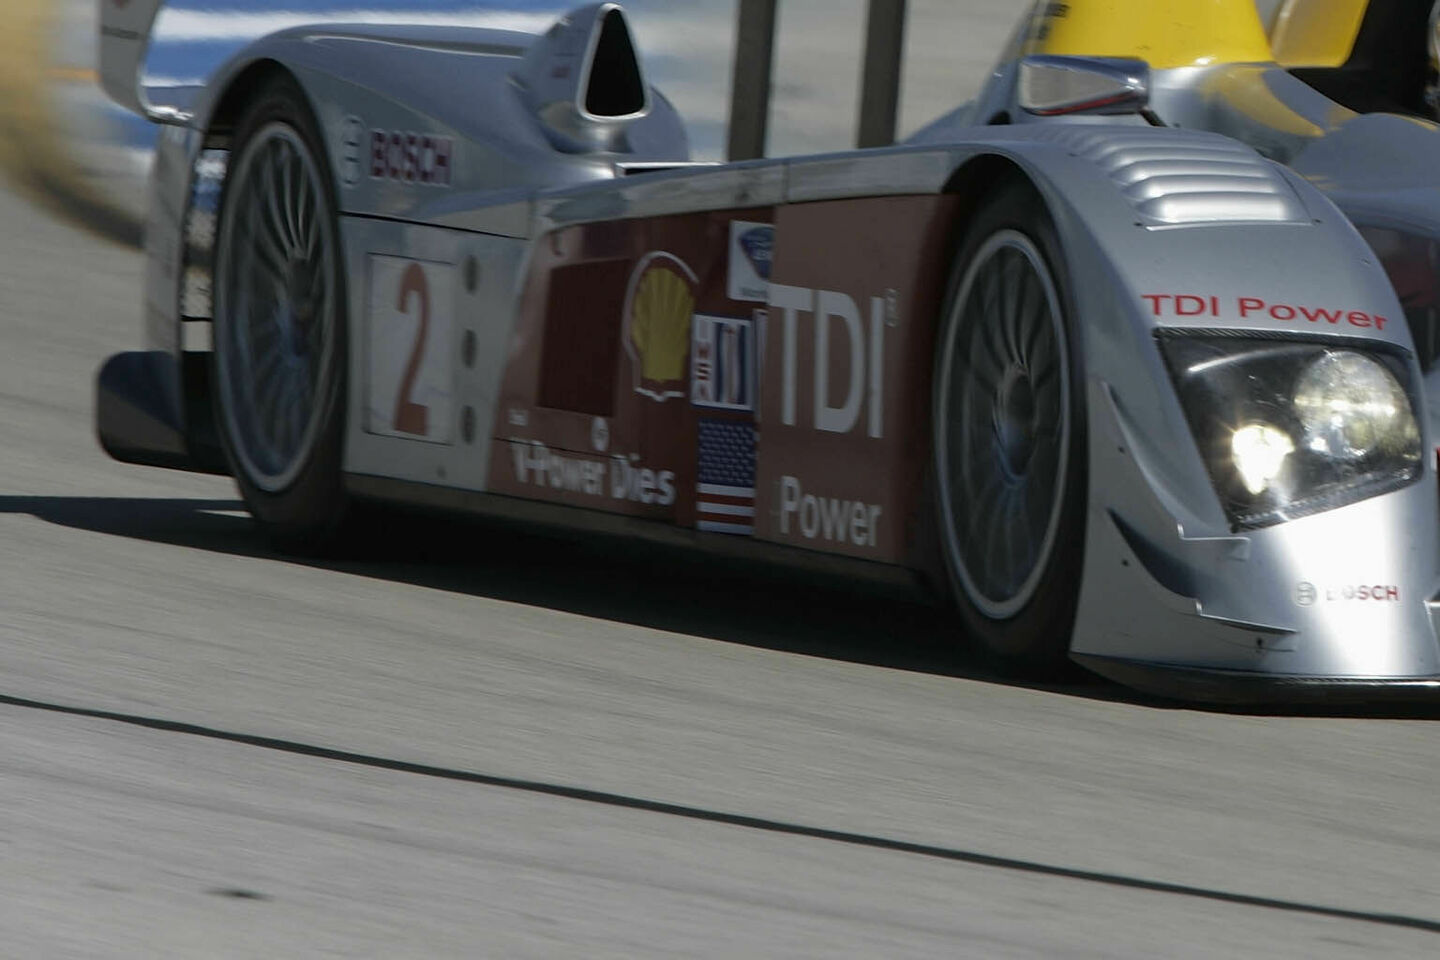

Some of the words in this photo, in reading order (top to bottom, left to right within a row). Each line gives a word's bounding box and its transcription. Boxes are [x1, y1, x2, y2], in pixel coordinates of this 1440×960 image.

[370, 131, 451, 185] BOSCH
[1142, 294, 1220, 317] TDI
[1238, 297, 1389, 330] Power
[393, 262, 429, 436] 2
[769, 284, 884, 439] TDI
[779, 475, 882, 548] Power
